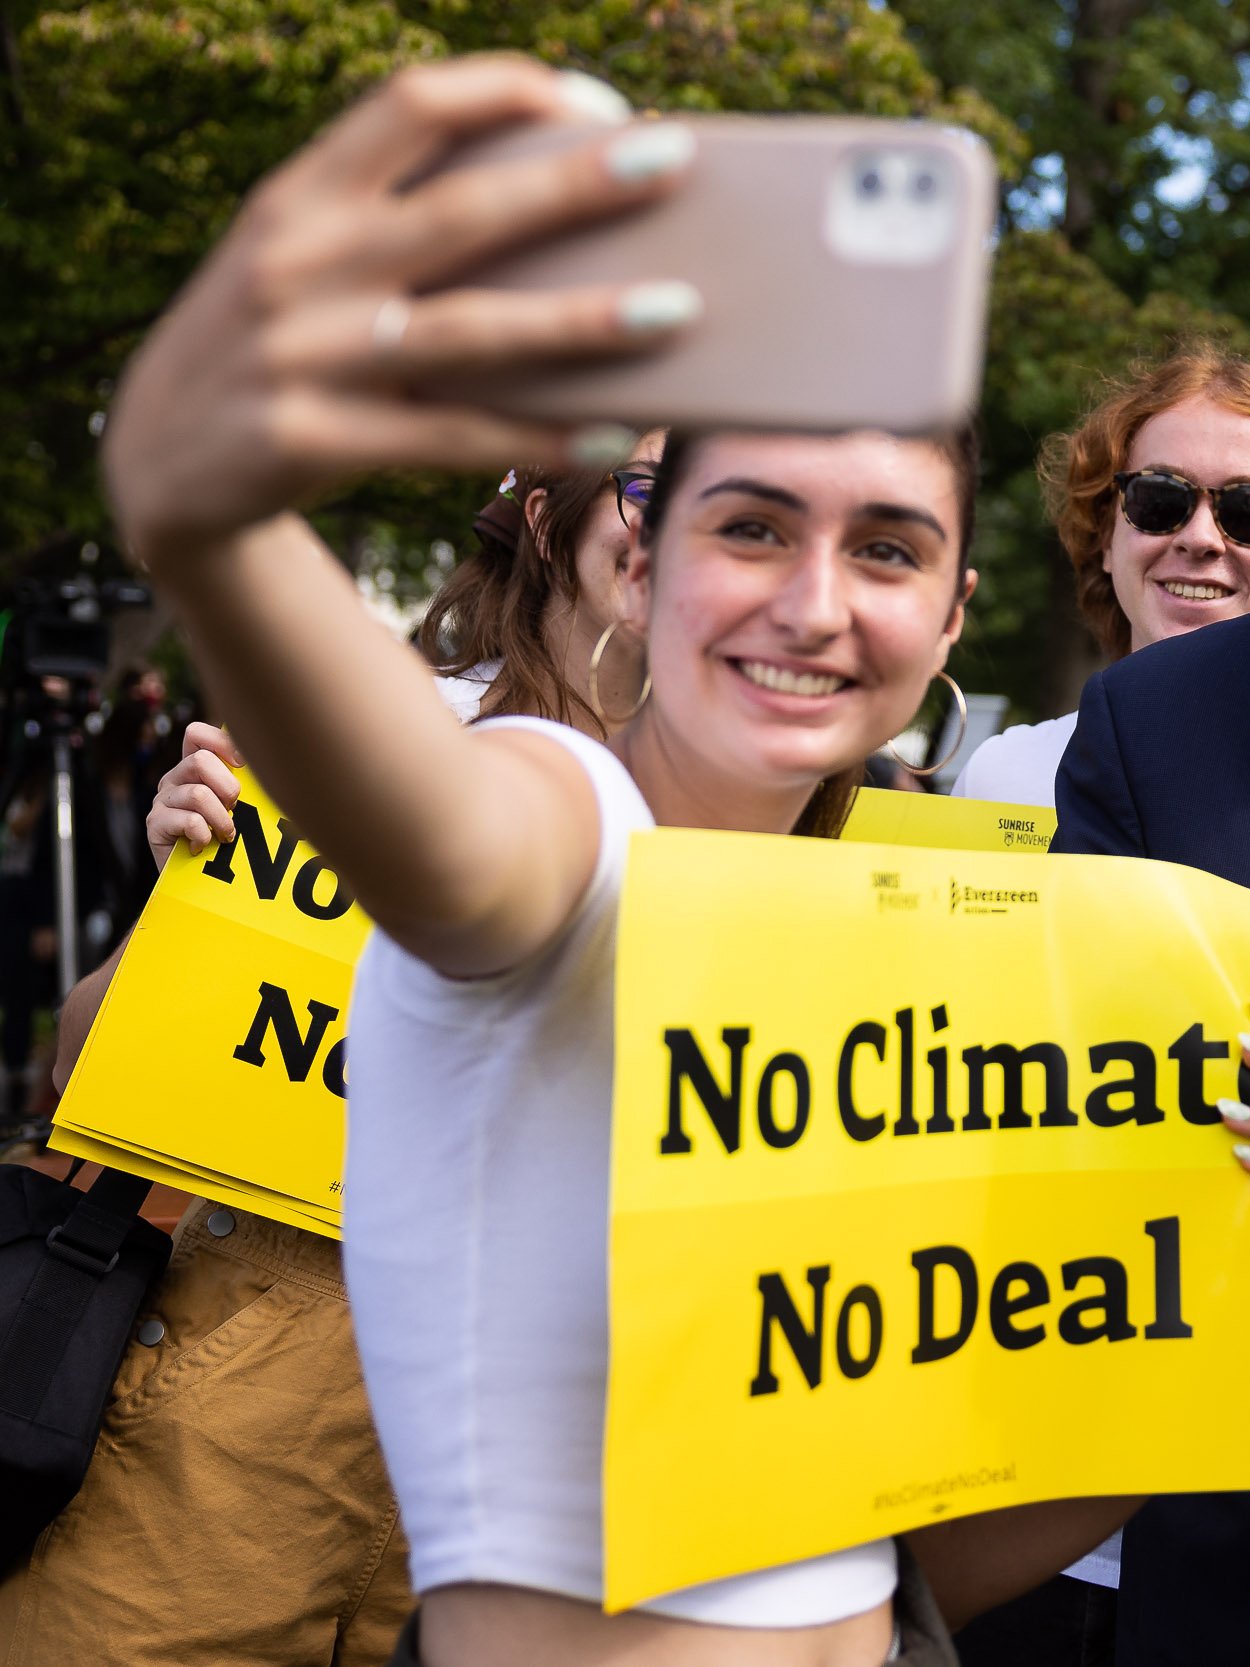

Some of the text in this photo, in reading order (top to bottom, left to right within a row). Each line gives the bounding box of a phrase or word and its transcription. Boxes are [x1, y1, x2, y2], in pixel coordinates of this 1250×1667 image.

[998, 818, 1035, 833] SUNRISE
[964, 886, 1038, 902] Evergreen
[659, 1027, 811, 1154] No
[750, 1216, 1192, 1397] No Deal
